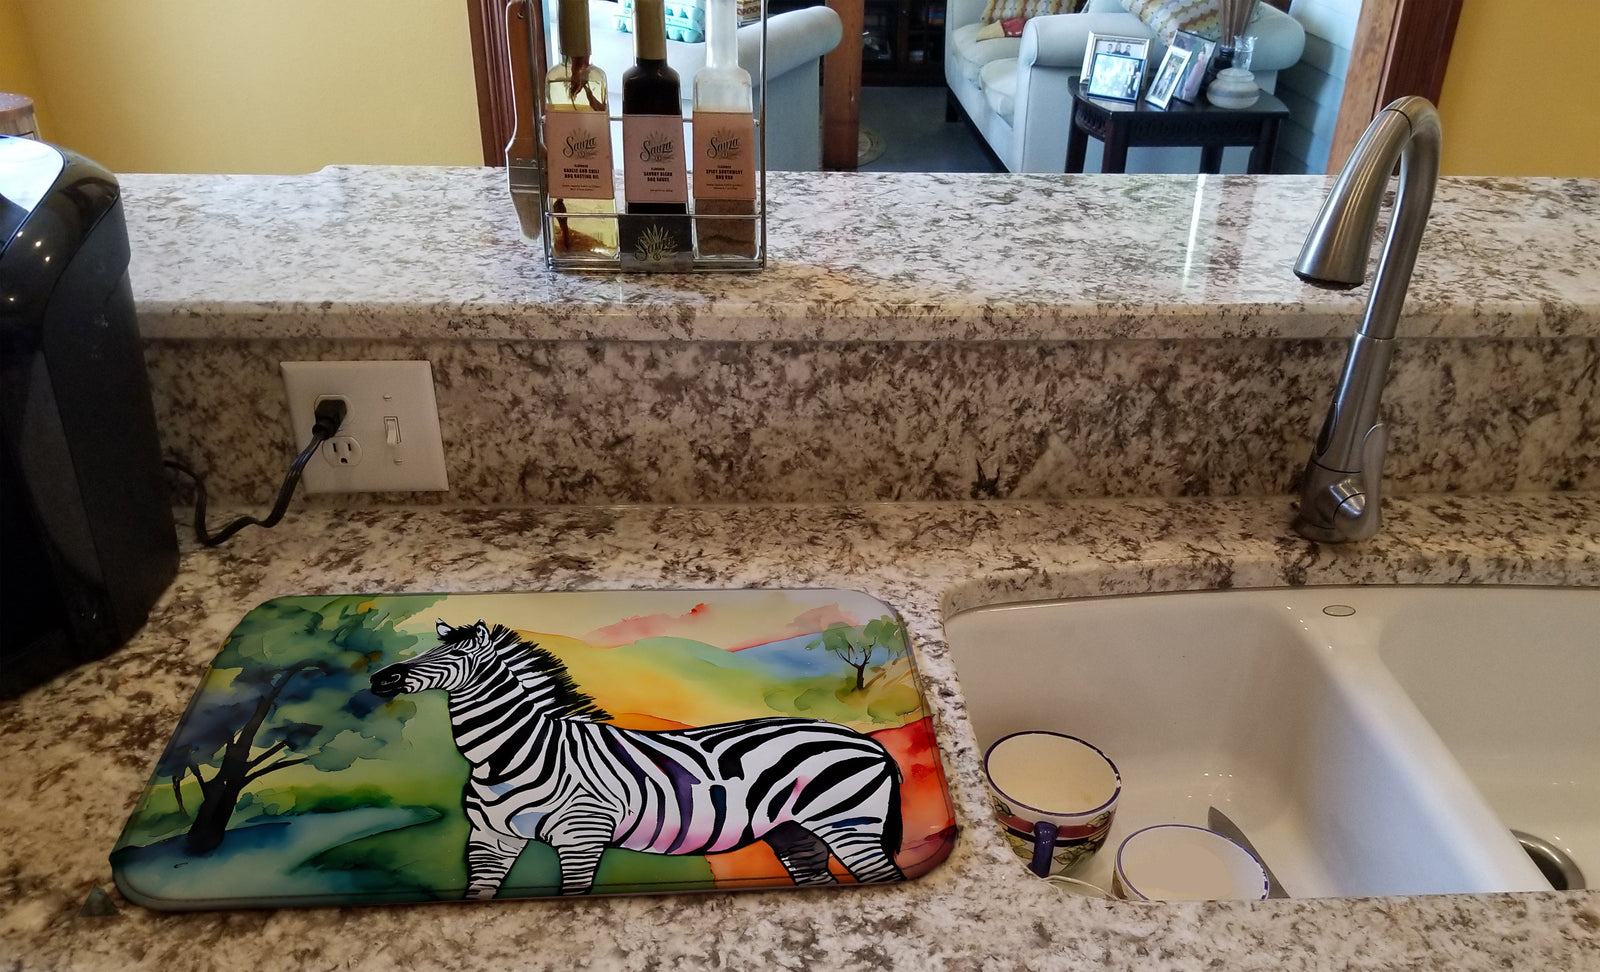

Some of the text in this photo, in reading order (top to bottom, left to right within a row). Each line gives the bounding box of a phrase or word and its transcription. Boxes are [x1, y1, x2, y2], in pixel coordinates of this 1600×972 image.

[563, 136, 597, 158] Sauza
[640, 140, 673, 162] Sauza
[707, 137, 740, 159] Sauza
